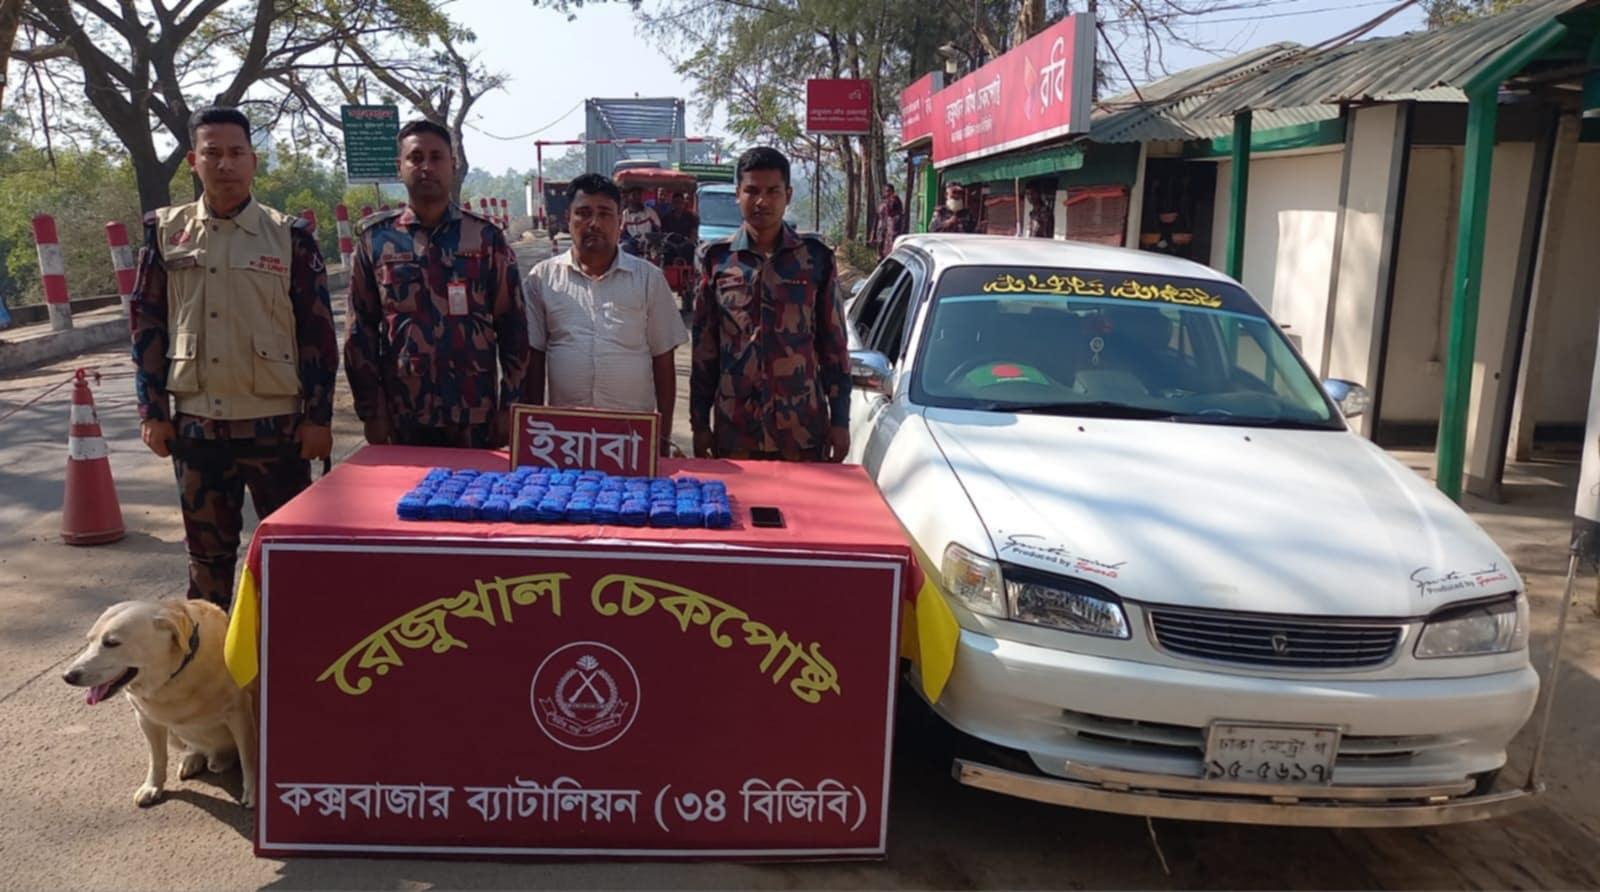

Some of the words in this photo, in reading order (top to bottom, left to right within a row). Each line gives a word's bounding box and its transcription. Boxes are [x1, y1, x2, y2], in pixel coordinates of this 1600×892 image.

[1040, 37, 1067, 115] রবি
[526, 415, 643, 471] ইয়াবা
[1012, 547, 1058, 563] Produced
[1060, 557, 1071, 567] by
[315, 572, 571, 695] রেজুখাল
[1208, 760, 1326, 782] ১৫-৫৬১৭
[275, 781, 455, 821] কক্সবাজার
[464, 775, 642, 824] ব্যাটালিয়ন
[654, 784, 727, 832] (৩৪
[738, 778, 867, 832] বিজিবি)
